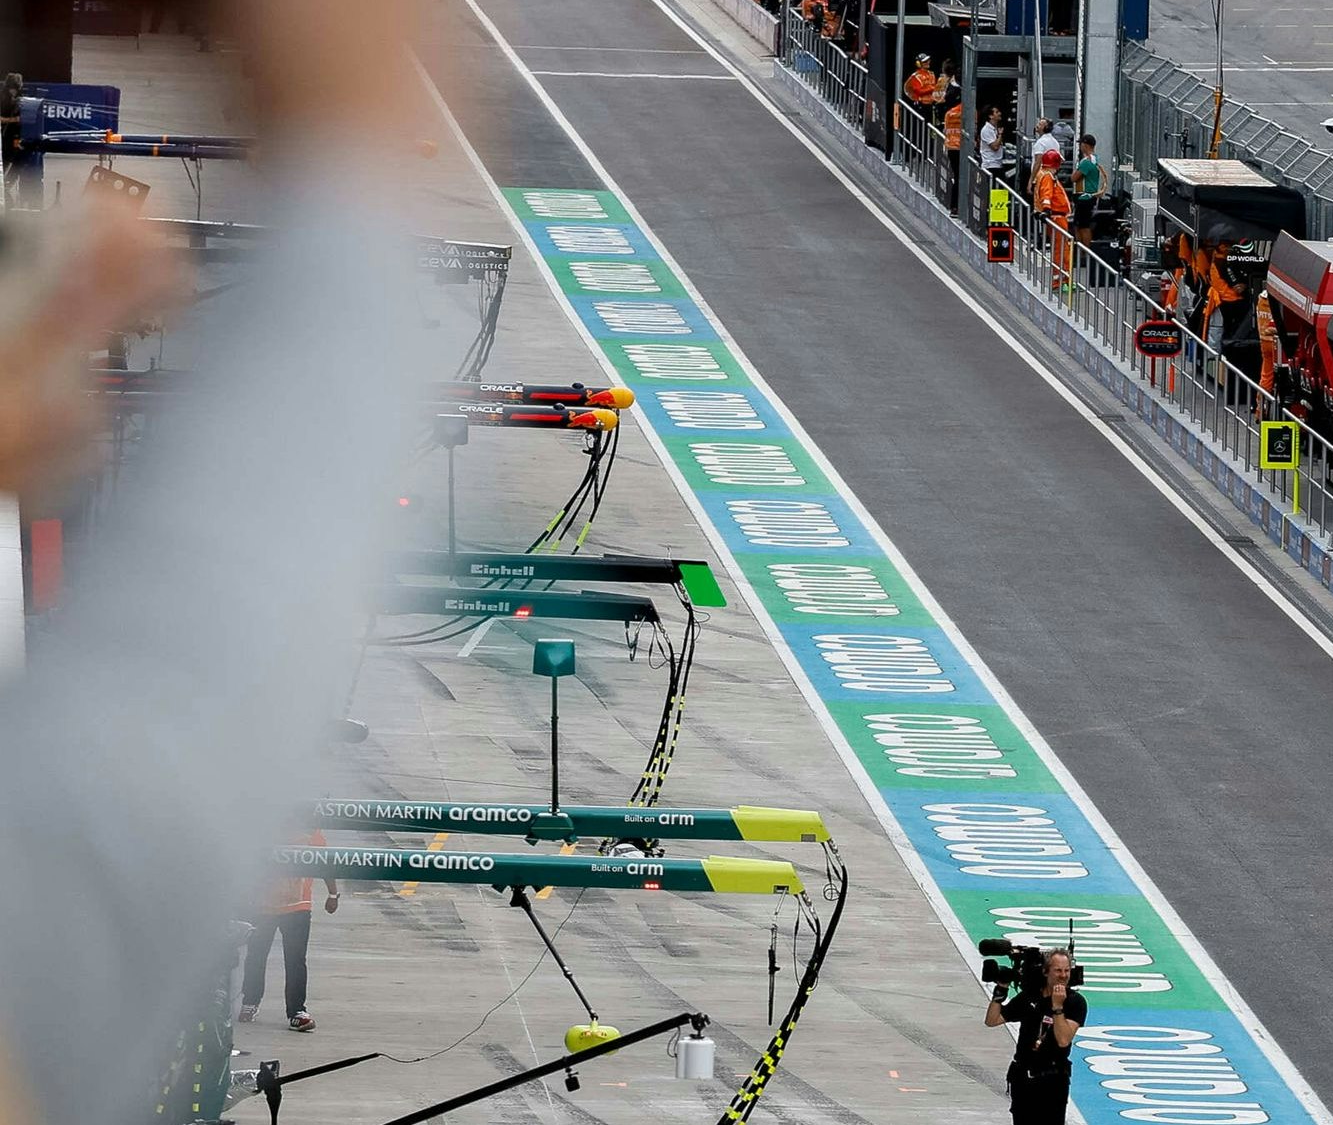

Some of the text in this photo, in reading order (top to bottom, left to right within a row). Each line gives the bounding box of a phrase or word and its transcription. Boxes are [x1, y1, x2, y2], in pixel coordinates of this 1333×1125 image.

[1238, 255, 1265, 263] WORLD
[459, 405, 503, 413] ORACLE
[470, 564, 534, 575] Einhell
[445, 600, 510, 611] Einhell
[313, 803, 372, 819] ASTON
[376, 805, 442, 820] MARTIN
[449, 806, 531, 822] aramco
[624, 814, 643, 823] Built
[659, 813, 694, 825] arm
[334, 852, 402, 868] MARTIN
[409, 854, 494, 871] aramco
[591, 864, 611, 872] Built
[627, 863, 663, 875] arm
